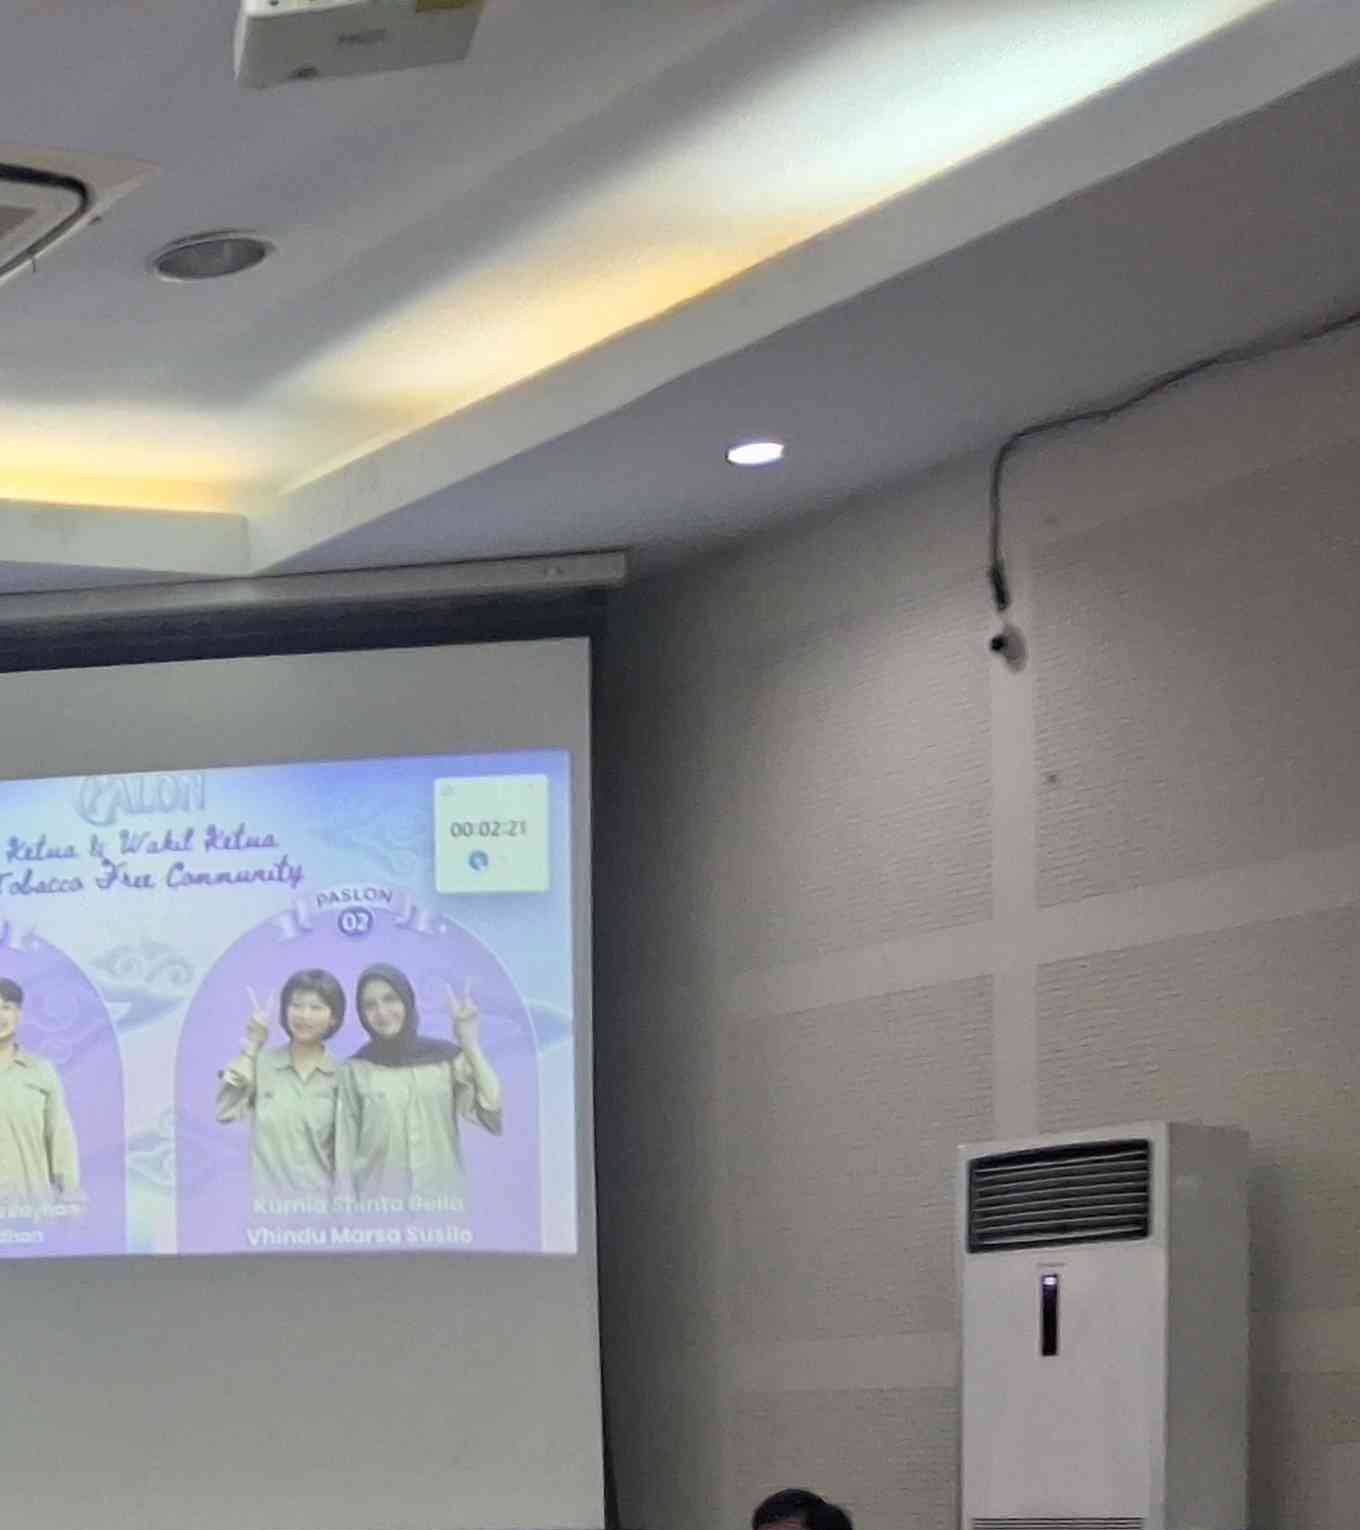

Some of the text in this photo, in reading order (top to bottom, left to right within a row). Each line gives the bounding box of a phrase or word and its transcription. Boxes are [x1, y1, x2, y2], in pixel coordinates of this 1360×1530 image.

[73, 773, 207, 826] CALON
[449, 820, 528, 840] 00:02:21
[315, 887, 394, 907] PASLON
[340, 911, 371, 932] 02
